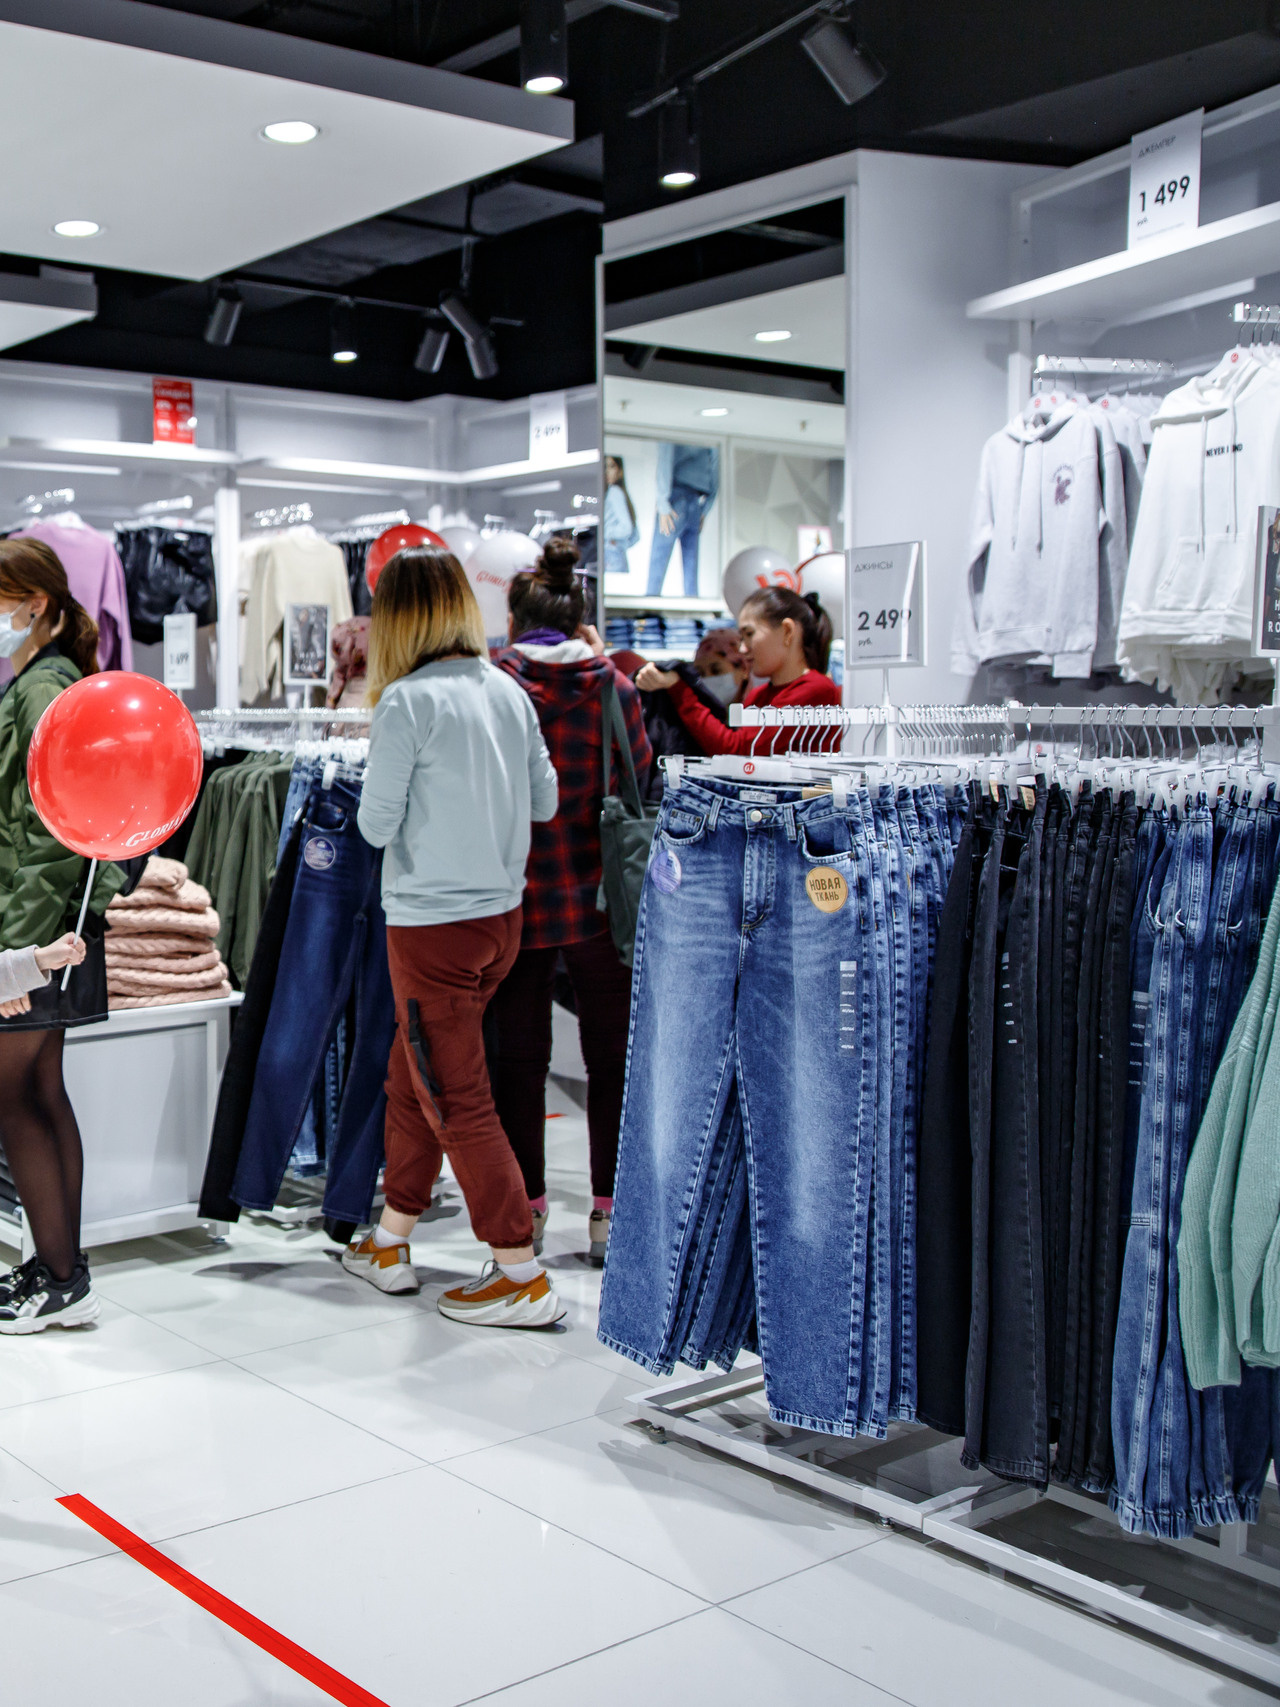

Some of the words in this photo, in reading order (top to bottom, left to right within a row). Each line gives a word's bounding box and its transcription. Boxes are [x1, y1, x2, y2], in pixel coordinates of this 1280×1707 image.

[1139, 190, 1146, 212] 1
[1154, 175, 1191, 205] 499
[1206, 446, 1225, 456] NEVER
[854, 561, 894, 573] ДЖИНСЫ
[858, 611, 870, 631] 2
[125, 815, 180, 848] GLORIA
[808, 876, 841, 891] НОВАЯ
[815, 890, 840, 902] ТКАНЬ
